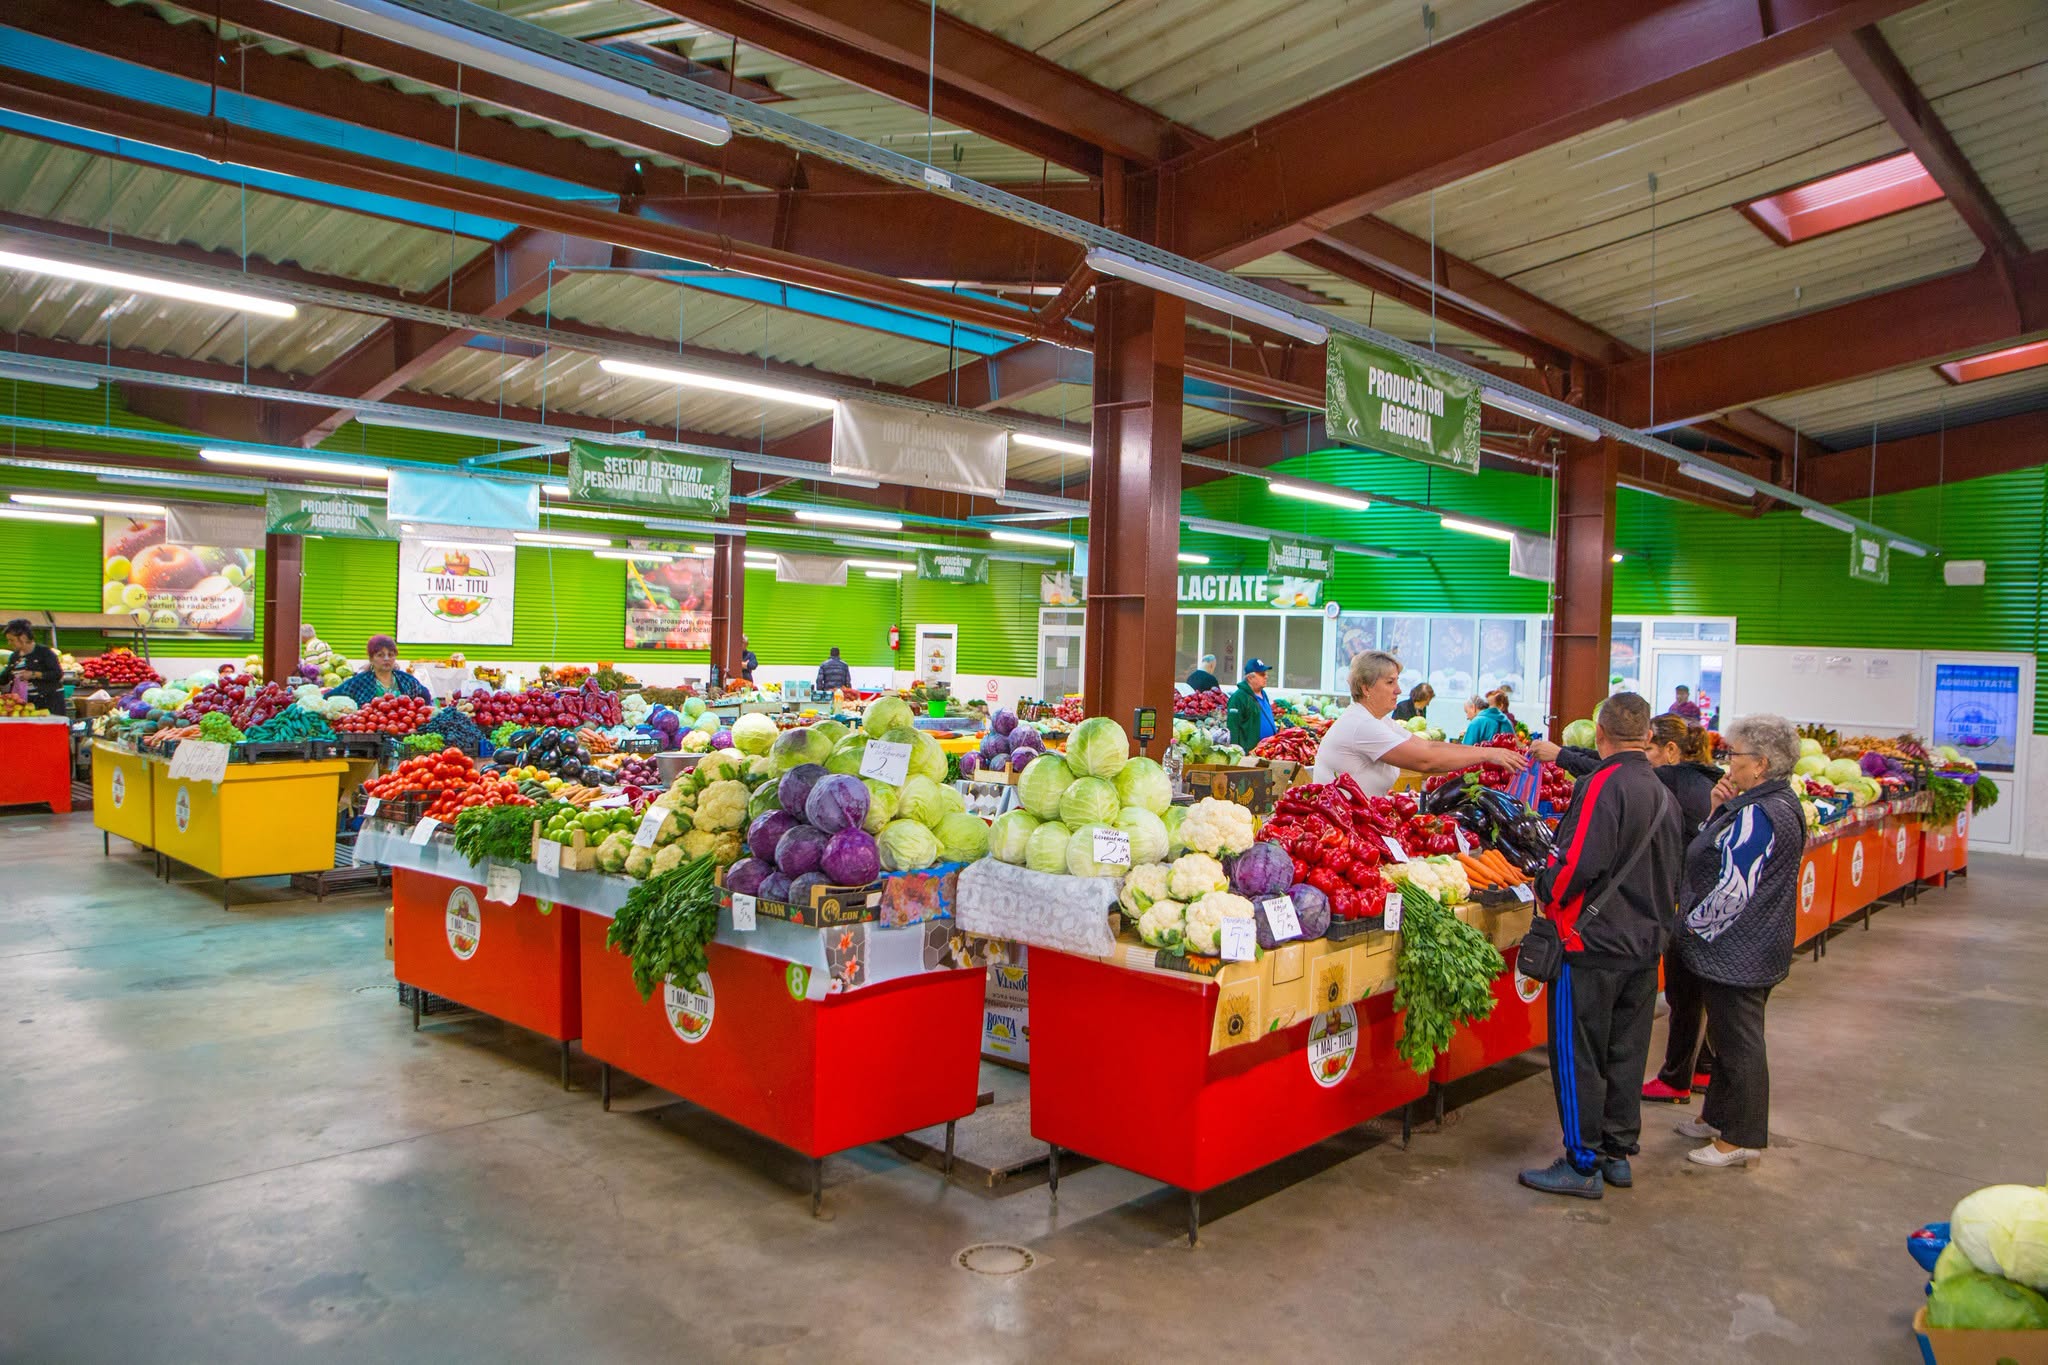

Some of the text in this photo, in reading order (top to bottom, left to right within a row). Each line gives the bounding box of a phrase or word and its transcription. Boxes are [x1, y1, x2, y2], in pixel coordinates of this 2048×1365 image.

[1368, 366, 1444, 418] PRODUCĂTORI
[1379, 402, 1431, 443] AGRICOLI
[604, 456, 703, 483] SECTOR REZERVAT
[583, 470, 715, 501] PERSOANELOR JURIDICE
[301, 499, 369, 518] PRODUCĂTORI
[311, 514, 357, 530] AGRICOLI
[427, 577, 432, 591] 1
[435, 578, 455, 592] MAI
[466, 579, 488, 594] TITU
[1177, 574, 1268, 602] LACTATE
[866, 756, 888, 774] 2
[1100, 841, 1119, 864] 2
[757, 900, 786, 917] LEON
[791, 966, 804, 996] 8
[671, 989, 675, 1001] 1
[676, 990, 689, 1007] MAI
[694, 996, 709, 1014] TITU
[986, 1011, 1017, 1038] BONITA
[1315, 1044, 1319, 1057] 1
[1320, 1037, 1333, 1056] MAI
[1339, 1031, 1352, 1049] TITU
